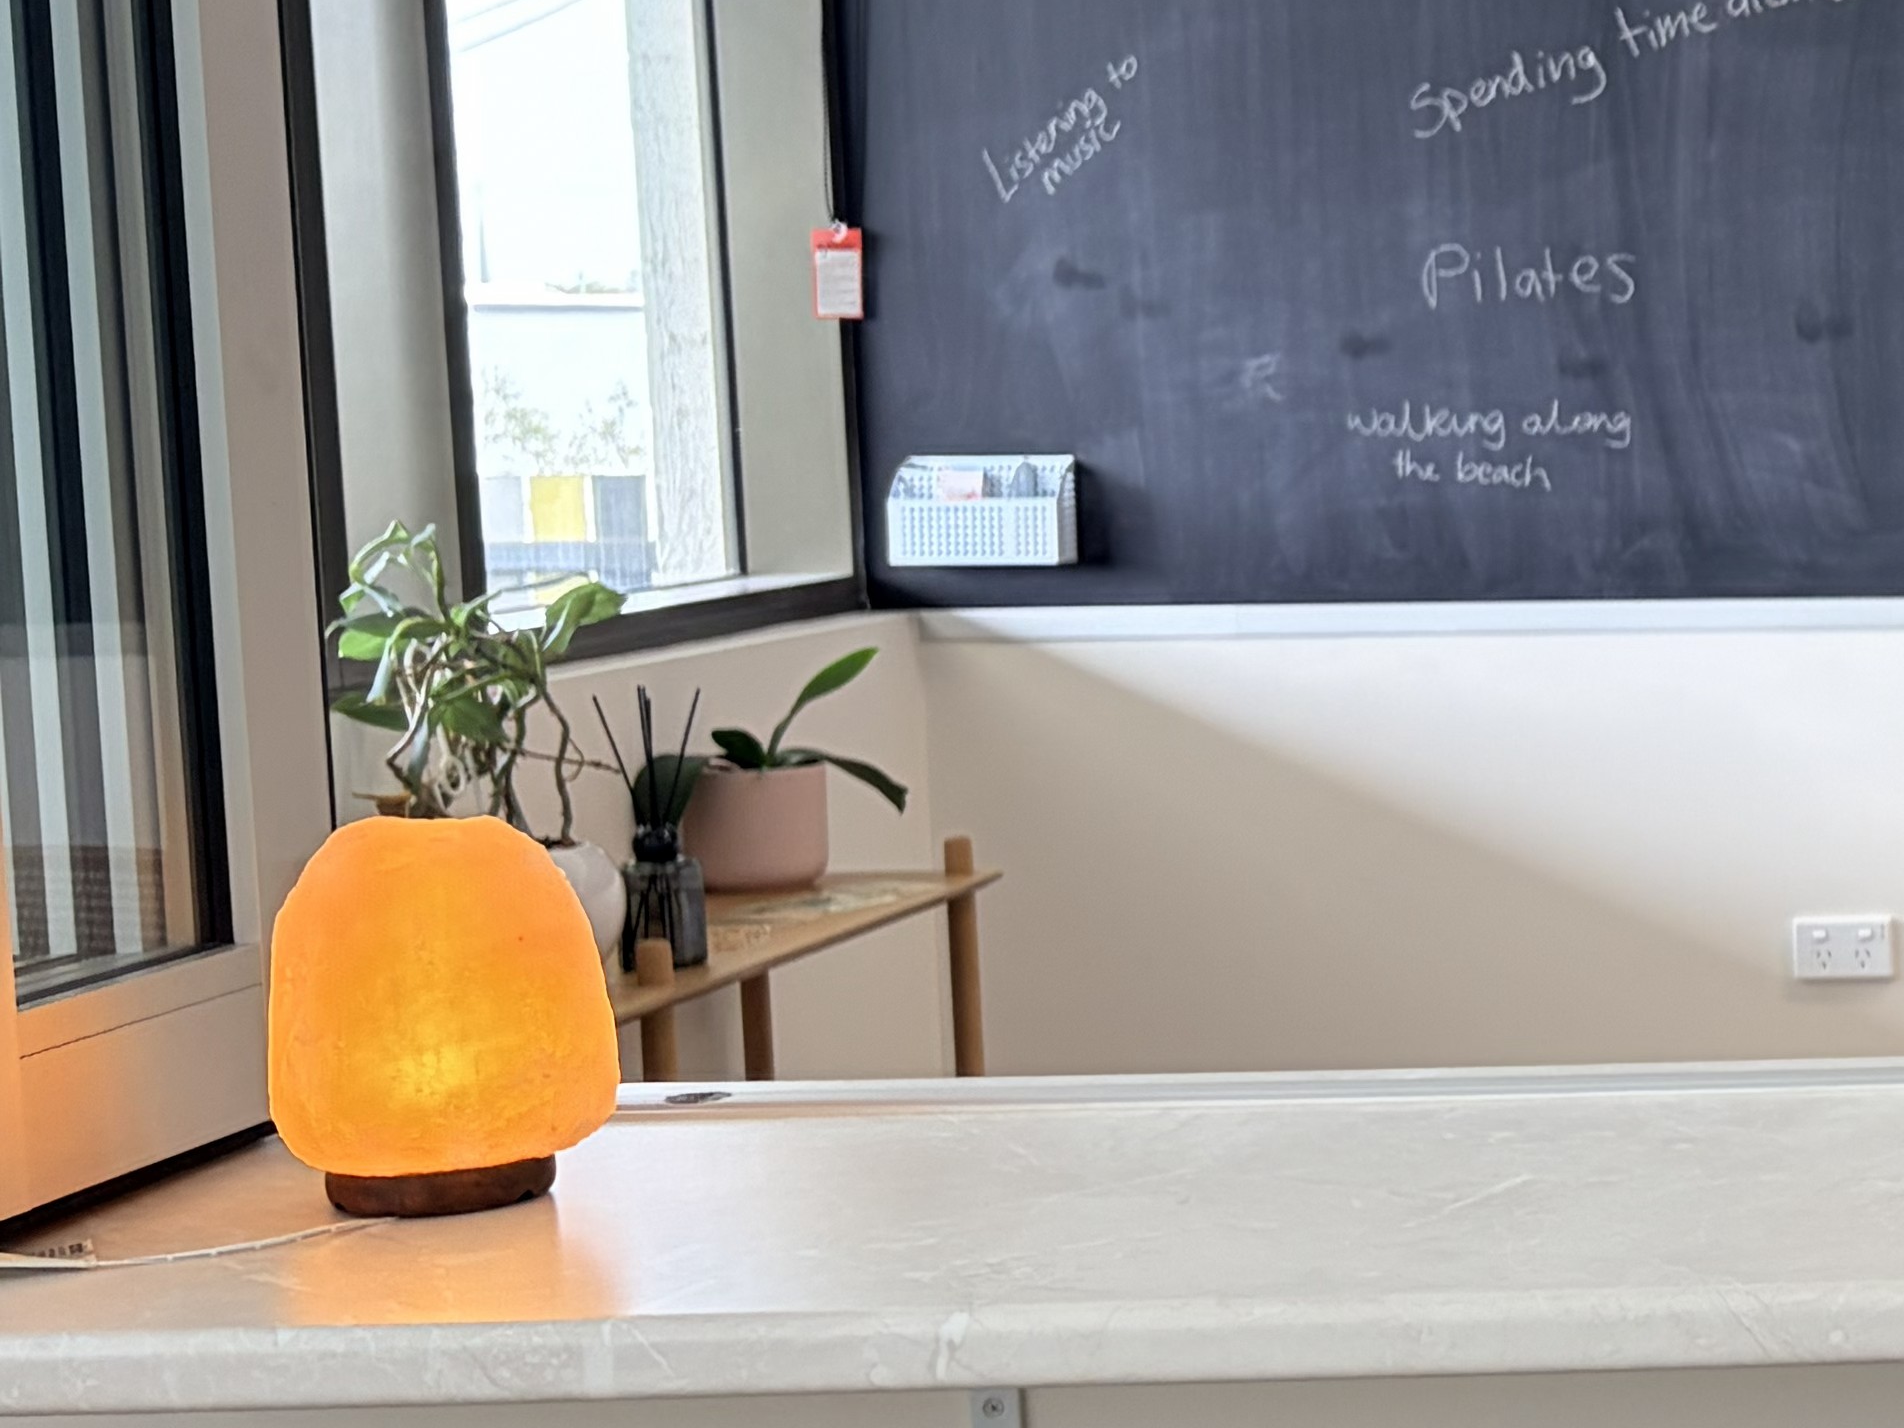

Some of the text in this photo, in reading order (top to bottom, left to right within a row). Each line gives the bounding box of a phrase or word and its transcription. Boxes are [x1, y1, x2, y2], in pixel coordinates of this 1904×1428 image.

[1410, 45, 1607, 138] Spending
[1615, 0, 1717, 58] time
[982, 54, 1138, 203] Listening to
[1042, 120, 1122, 195] music
[1422, 242, 1637, 310] Pilates
[1521, 398, 1632, 449] along
[1393, 447, 1552, 492] the beach
